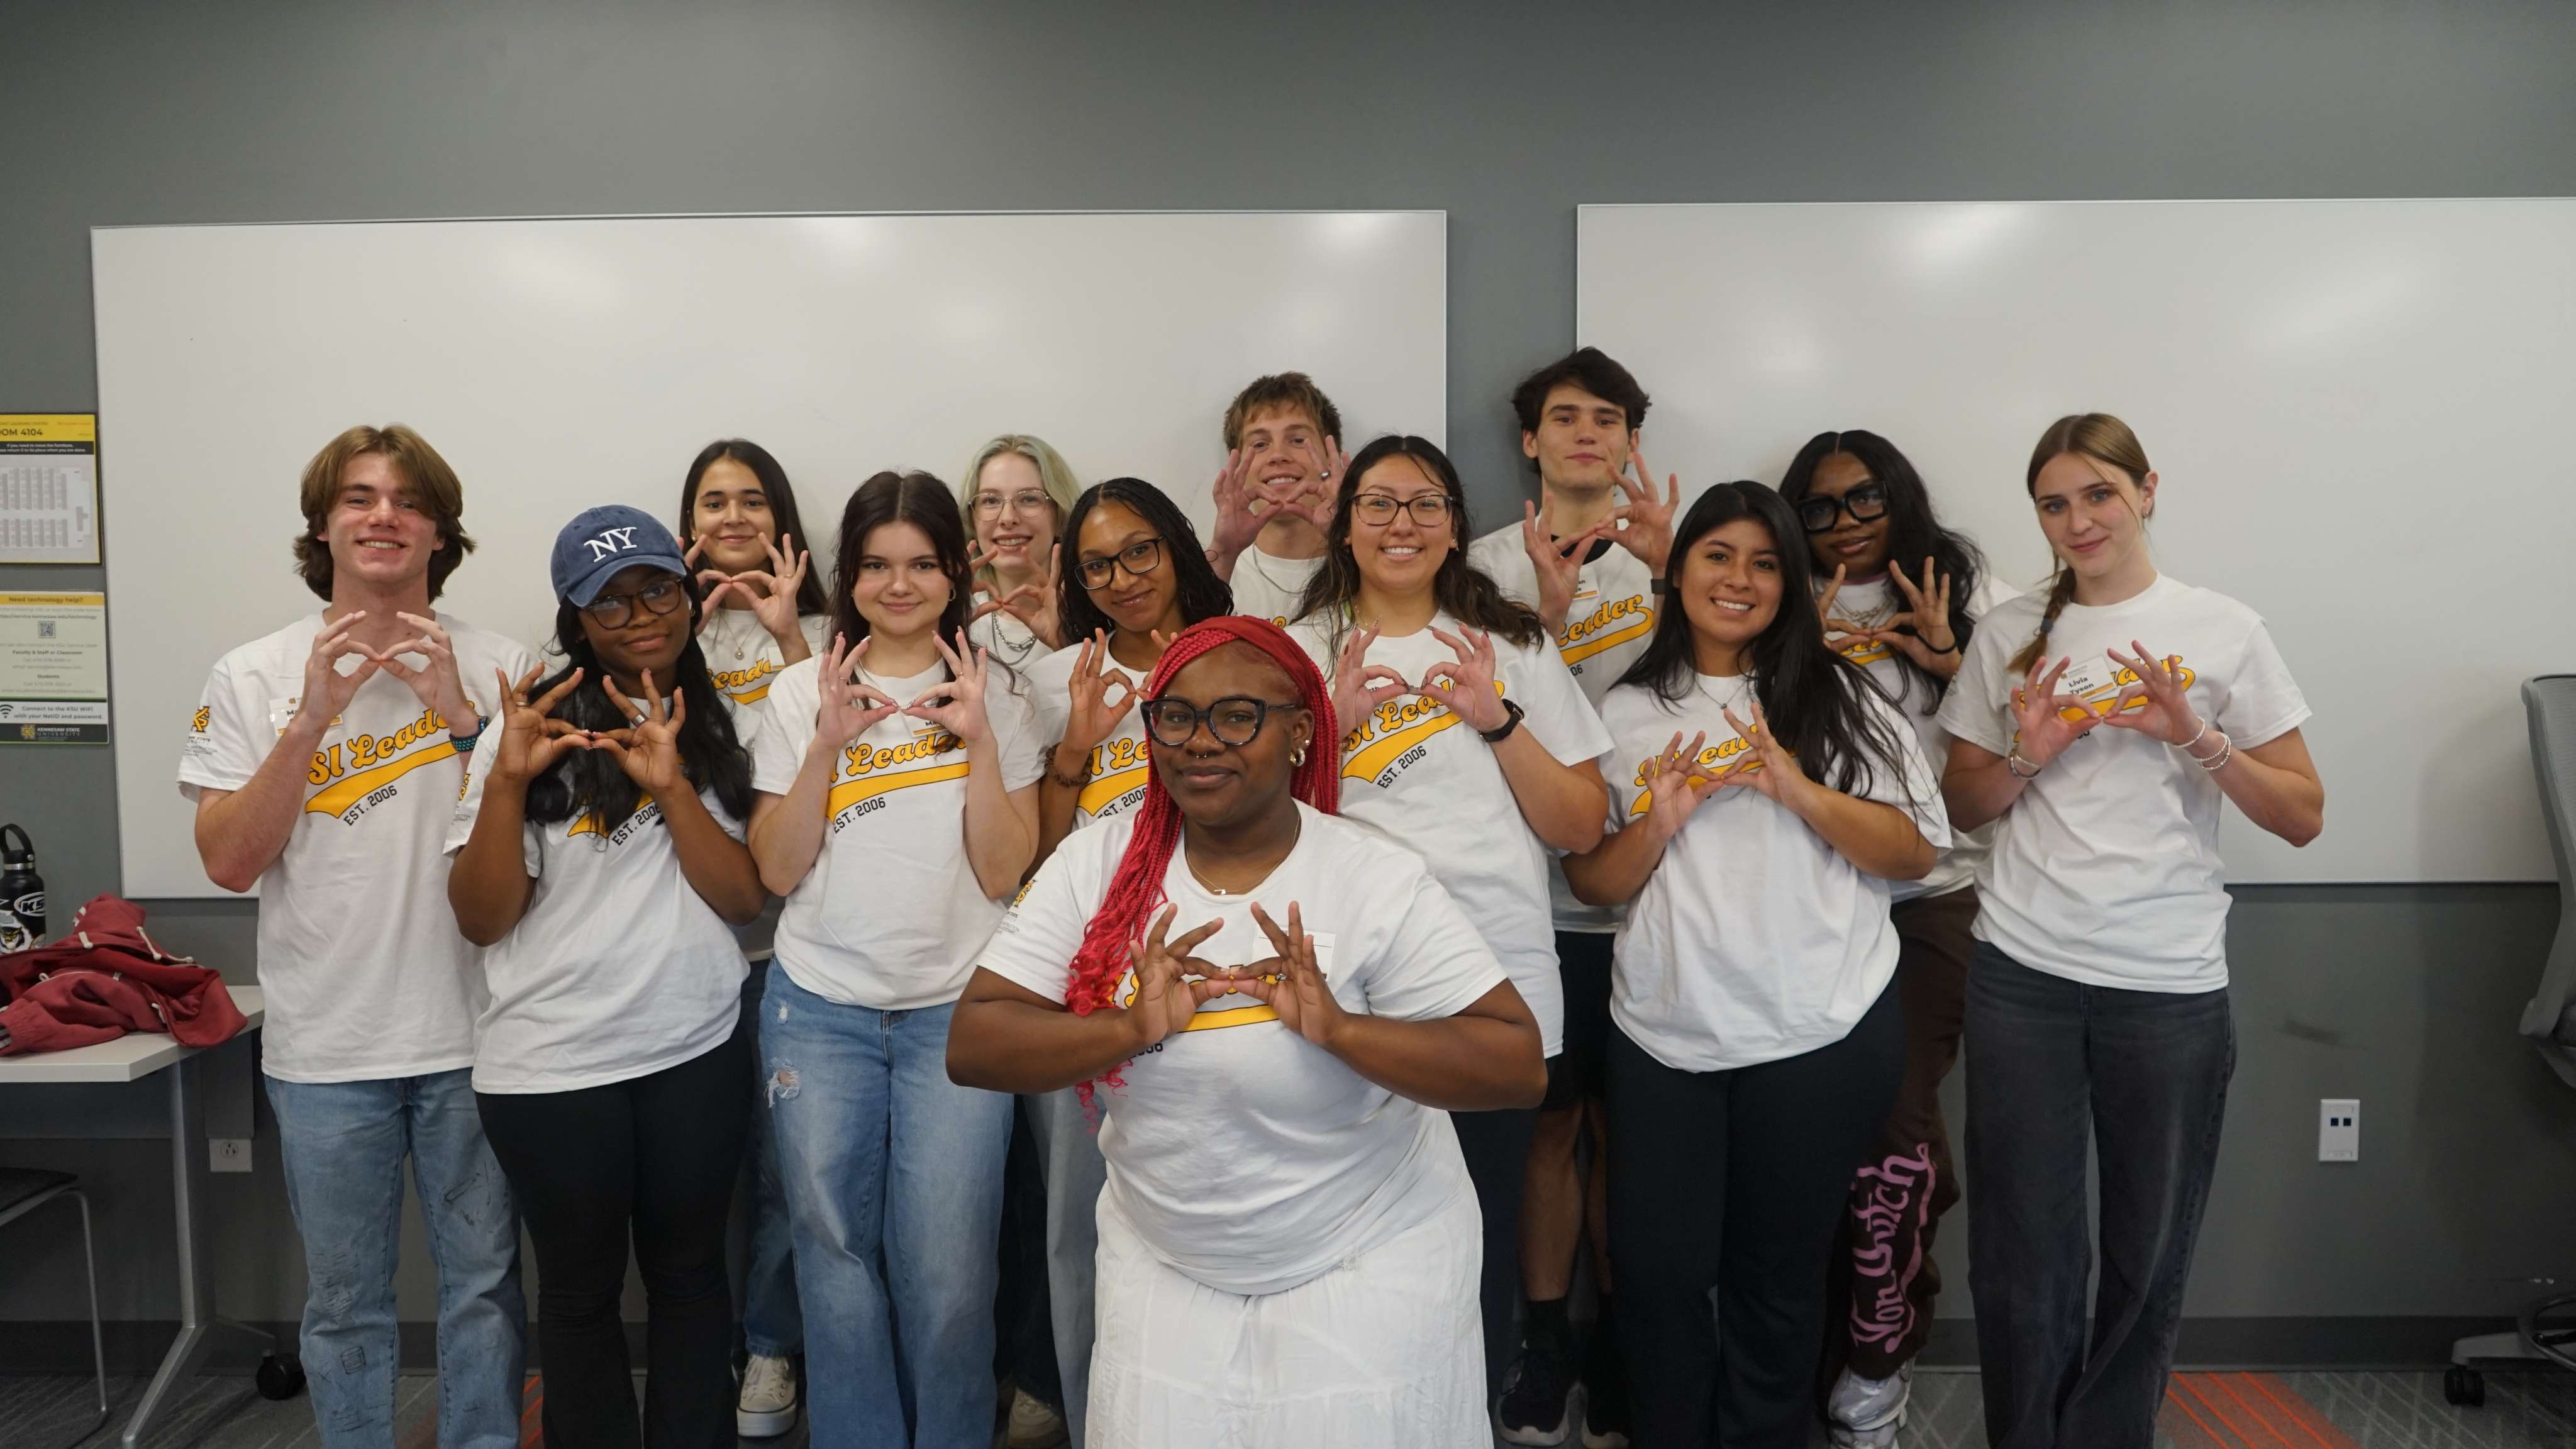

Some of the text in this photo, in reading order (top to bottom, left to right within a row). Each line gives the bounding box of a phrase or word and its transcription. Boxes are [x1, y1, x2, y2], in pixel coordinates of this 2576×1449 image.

[584, 526, 637, 563] NY
[706, 658, 772, 689] ead
[1570, 664, 1583, 676] 06
[2068, 677, 2089, 687] Livia
[2069, 683, 2095, 694] Tyson
[1374, 679, 1458, 732] Lea
[347, 701, 475, 769] Lead
[1674, 724, 1757, 765] ead
[1377, 745, 1427, 789] EST. 2006
[343, 786, 397, 826] EST. 2006
[855, 797, 887, 816] 2006
[1097, 804, 1123, 819] ST.
[611, 823, 638, 846] EST.
